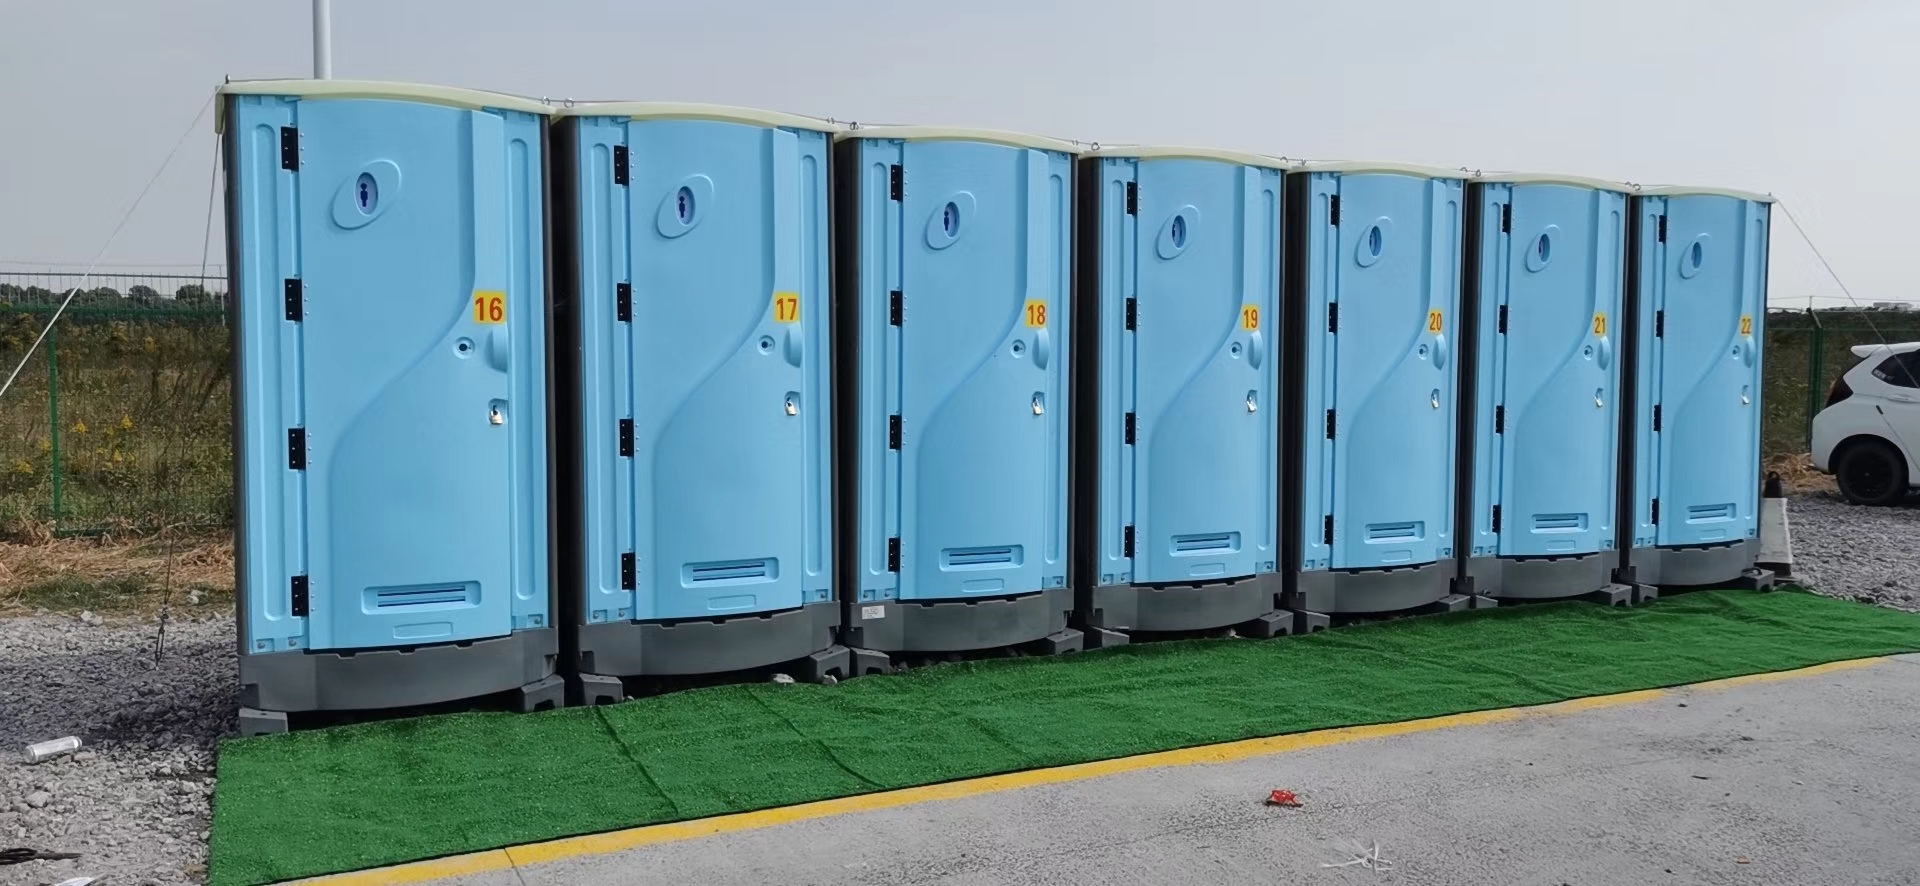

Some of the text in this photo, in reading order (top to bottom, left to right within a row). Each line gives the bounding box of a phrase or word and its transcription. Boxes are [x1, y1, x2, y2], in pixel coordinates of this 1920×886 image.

[475, 297, 503, 321] 16
[776, 298, 797, 321] 17
[1027, 304, 1046, 325] 18
[1243, 309, 1258, 329] 19
[1429, 313, 1442, 331] 20
[1594, 316, 1606, 334] 21
[1740, 318, 1752, 335] 22
